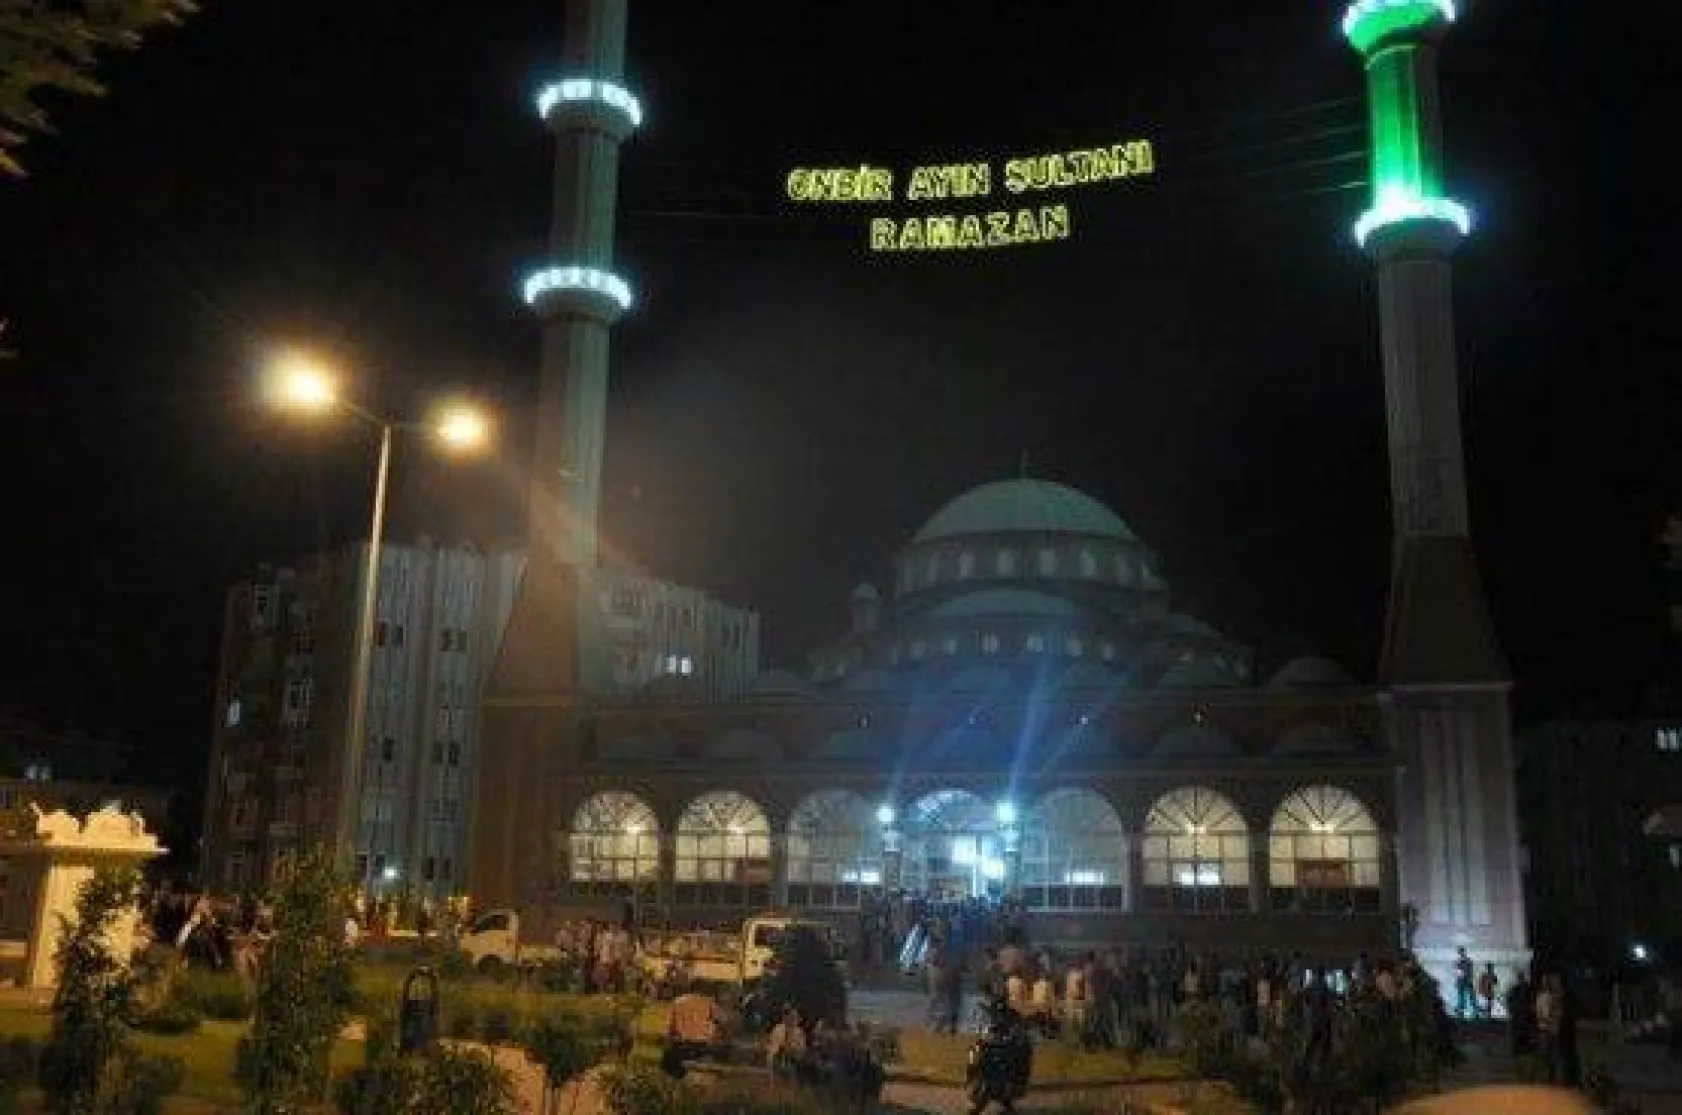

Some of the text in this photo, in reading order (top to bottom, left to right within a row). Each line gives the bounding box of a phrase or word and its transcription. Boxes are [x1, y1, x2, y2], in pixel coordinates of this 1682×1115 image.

[907, 163, 990, 200] AYIN
[1005, 139, 1154, 193] SULTANI
[870, 205, 1069, 250] RAMAZAN
